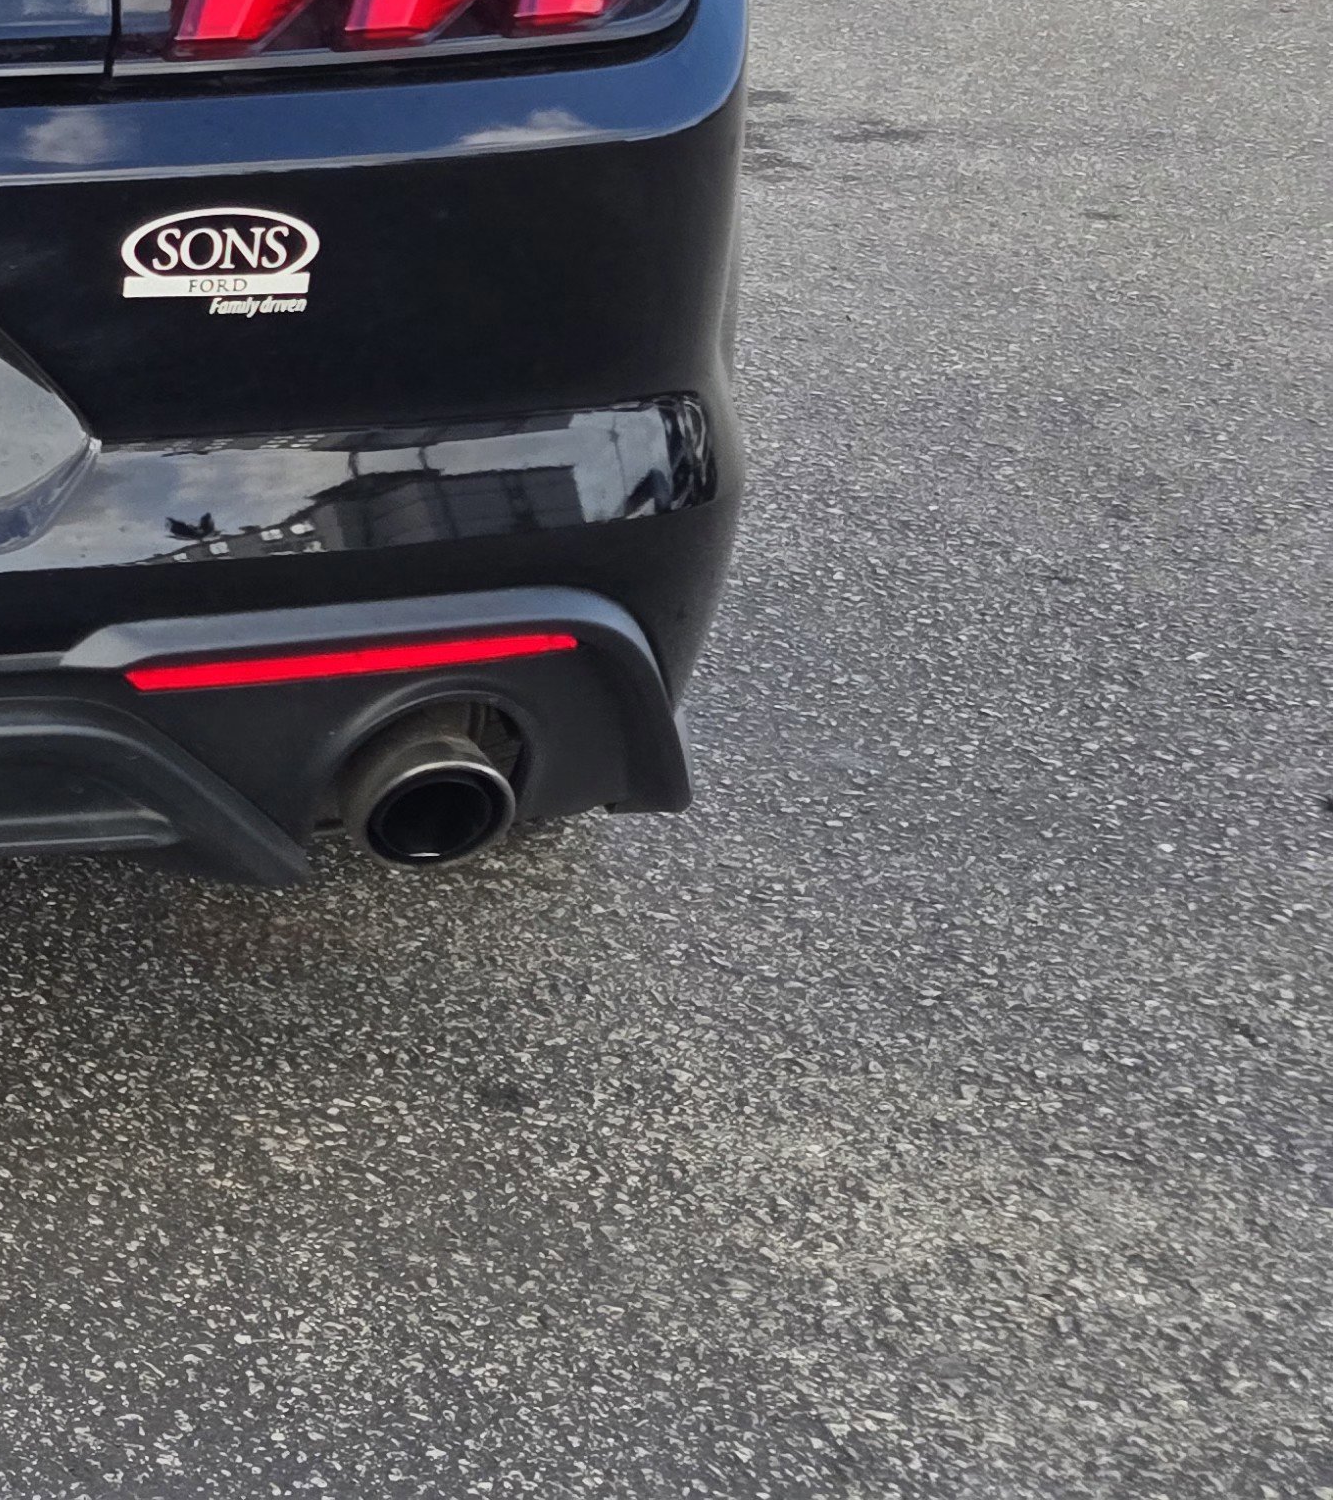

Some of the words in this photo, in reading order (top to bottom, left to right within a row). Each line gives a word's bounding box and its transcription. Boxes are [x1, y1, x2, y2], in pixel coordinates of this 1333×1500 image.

[151, 226, 290, 271] SONS
[187, 278, 248, 294] FORD
[208, 296, 261, 319] Family
[259, 295, 308, 314] driven
